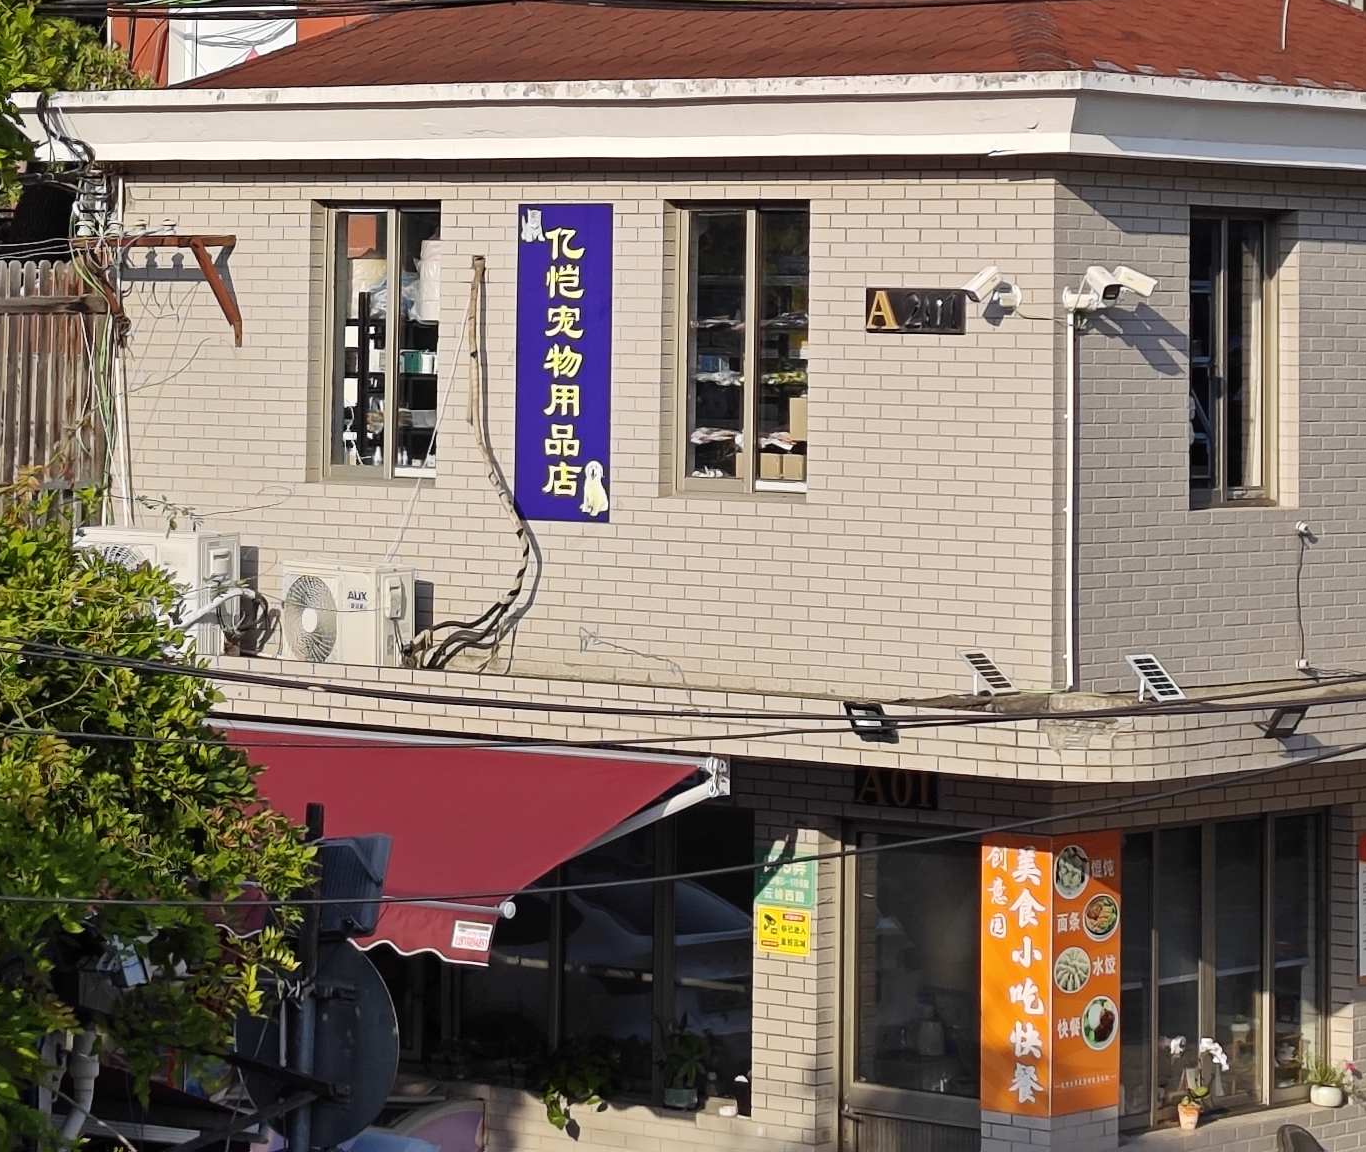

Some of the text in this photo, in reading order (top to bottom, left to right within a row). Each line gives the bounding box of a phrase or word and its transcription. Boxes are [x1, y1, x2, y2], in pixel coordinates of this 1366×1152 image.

[543, 227, 585, 498] 亿恺宠物用品店
[347, 590, 368, 601] AUX
[986, 847, 1009, 939] 创意园
[1056, 911, 1081, 934] 面条
[1009, 847, 1046, 1105] 美食小吃快餐
[1092, 954, 1117, 977] 水饺
[1056, 1016, 1082, 1040] 快餐
